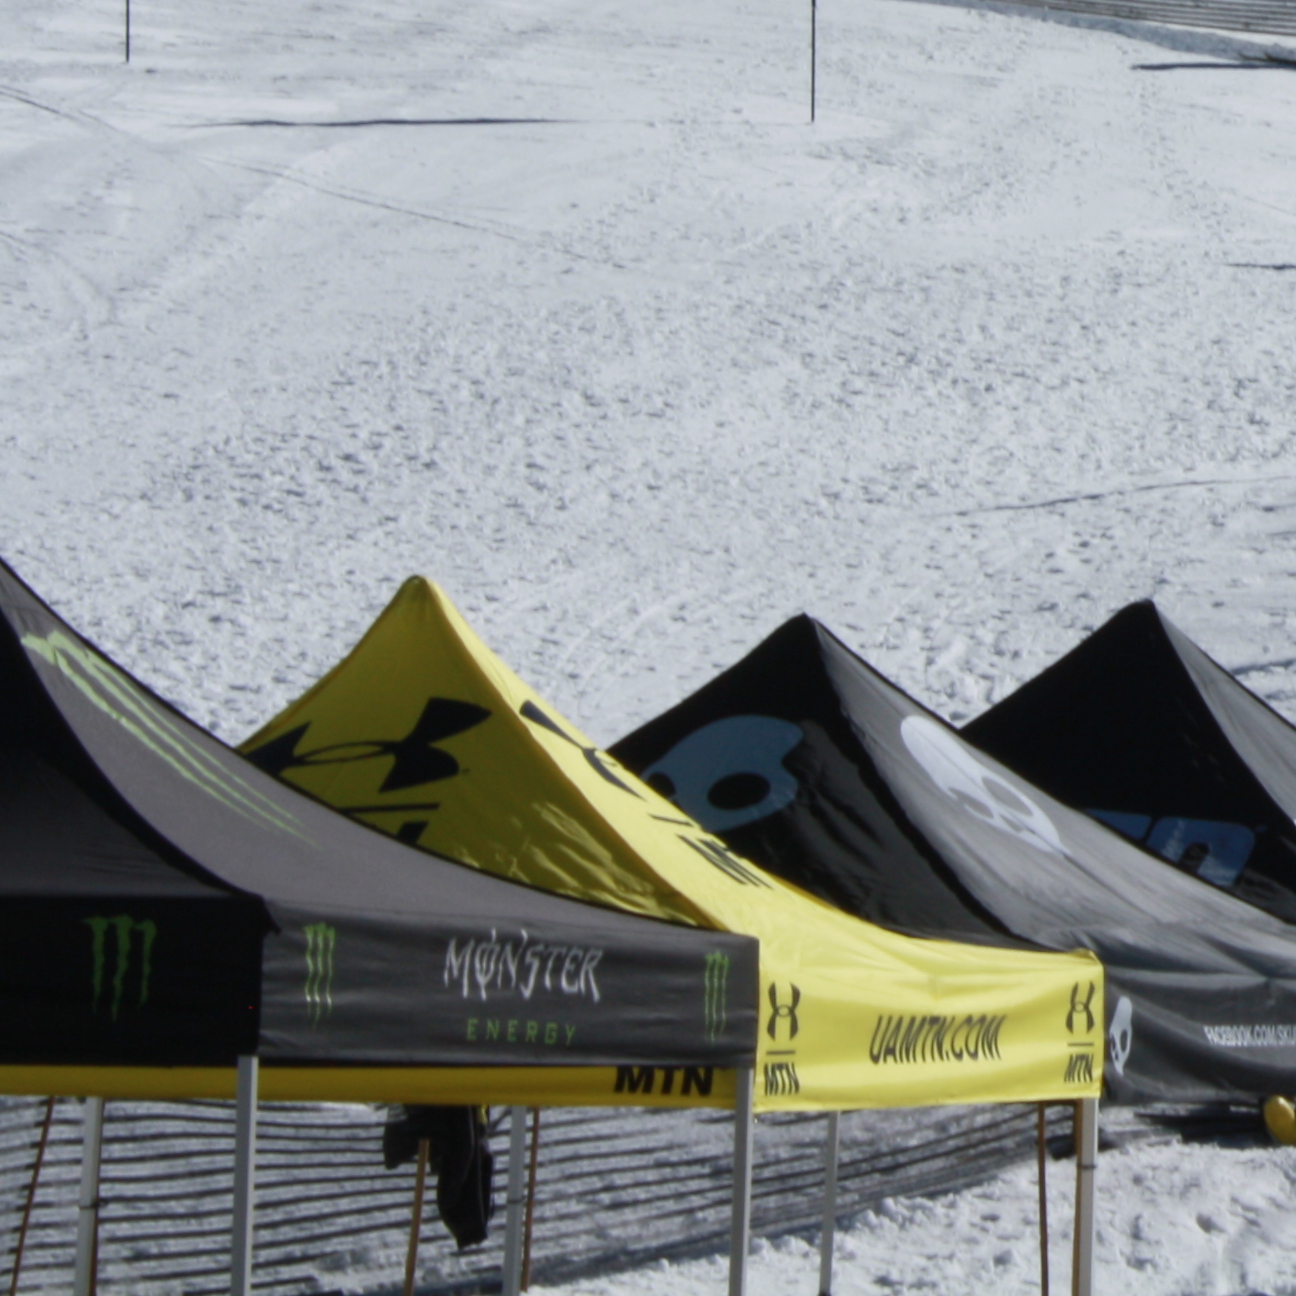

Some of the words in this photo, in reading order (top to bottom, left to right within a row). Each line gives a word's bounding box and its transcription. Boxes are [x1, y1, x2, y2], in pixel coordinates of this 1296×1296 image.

[443, 927, 604, 1004] MONSTER
[466, 1017, 577, 1046] ENERGY
[869, 1014, 1008, 1065] UAMTN.COM
[613, 1065, 714, 1096] MTN
[764, 1061, 800, 1096] MTN
[1063, 1053, 1094, 1083] MTN
